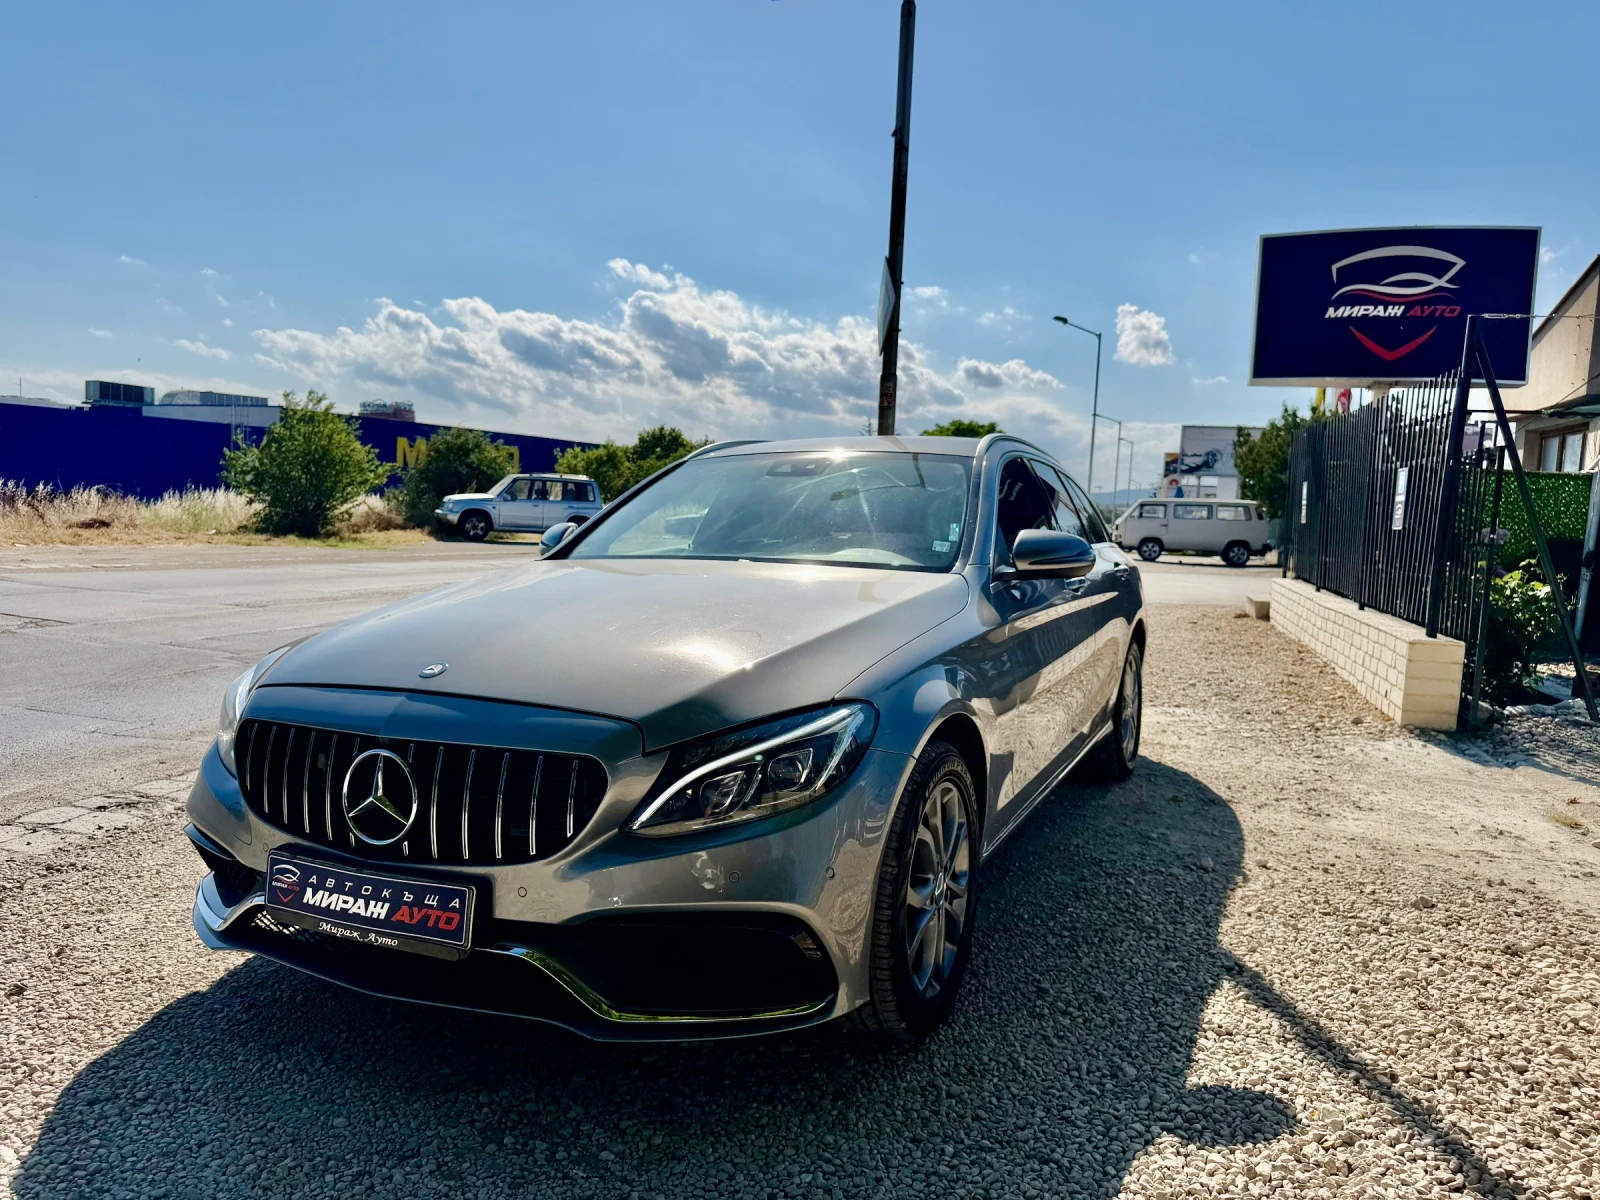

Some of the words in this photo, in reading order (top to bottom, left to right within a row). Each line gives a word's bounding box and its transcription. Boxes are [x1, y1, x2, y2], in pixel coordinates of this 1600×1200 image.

[1324, 305, 1405, 318] МИРАЖ
[1406, 305, 1461, 317] АУТО
[302, 886, 391, 920] МИРАЖ
[391, 905, 461, 931] АУТО
[318, 921, 363, 942] Мираж
[364, 932, 399, 947] Ауто
